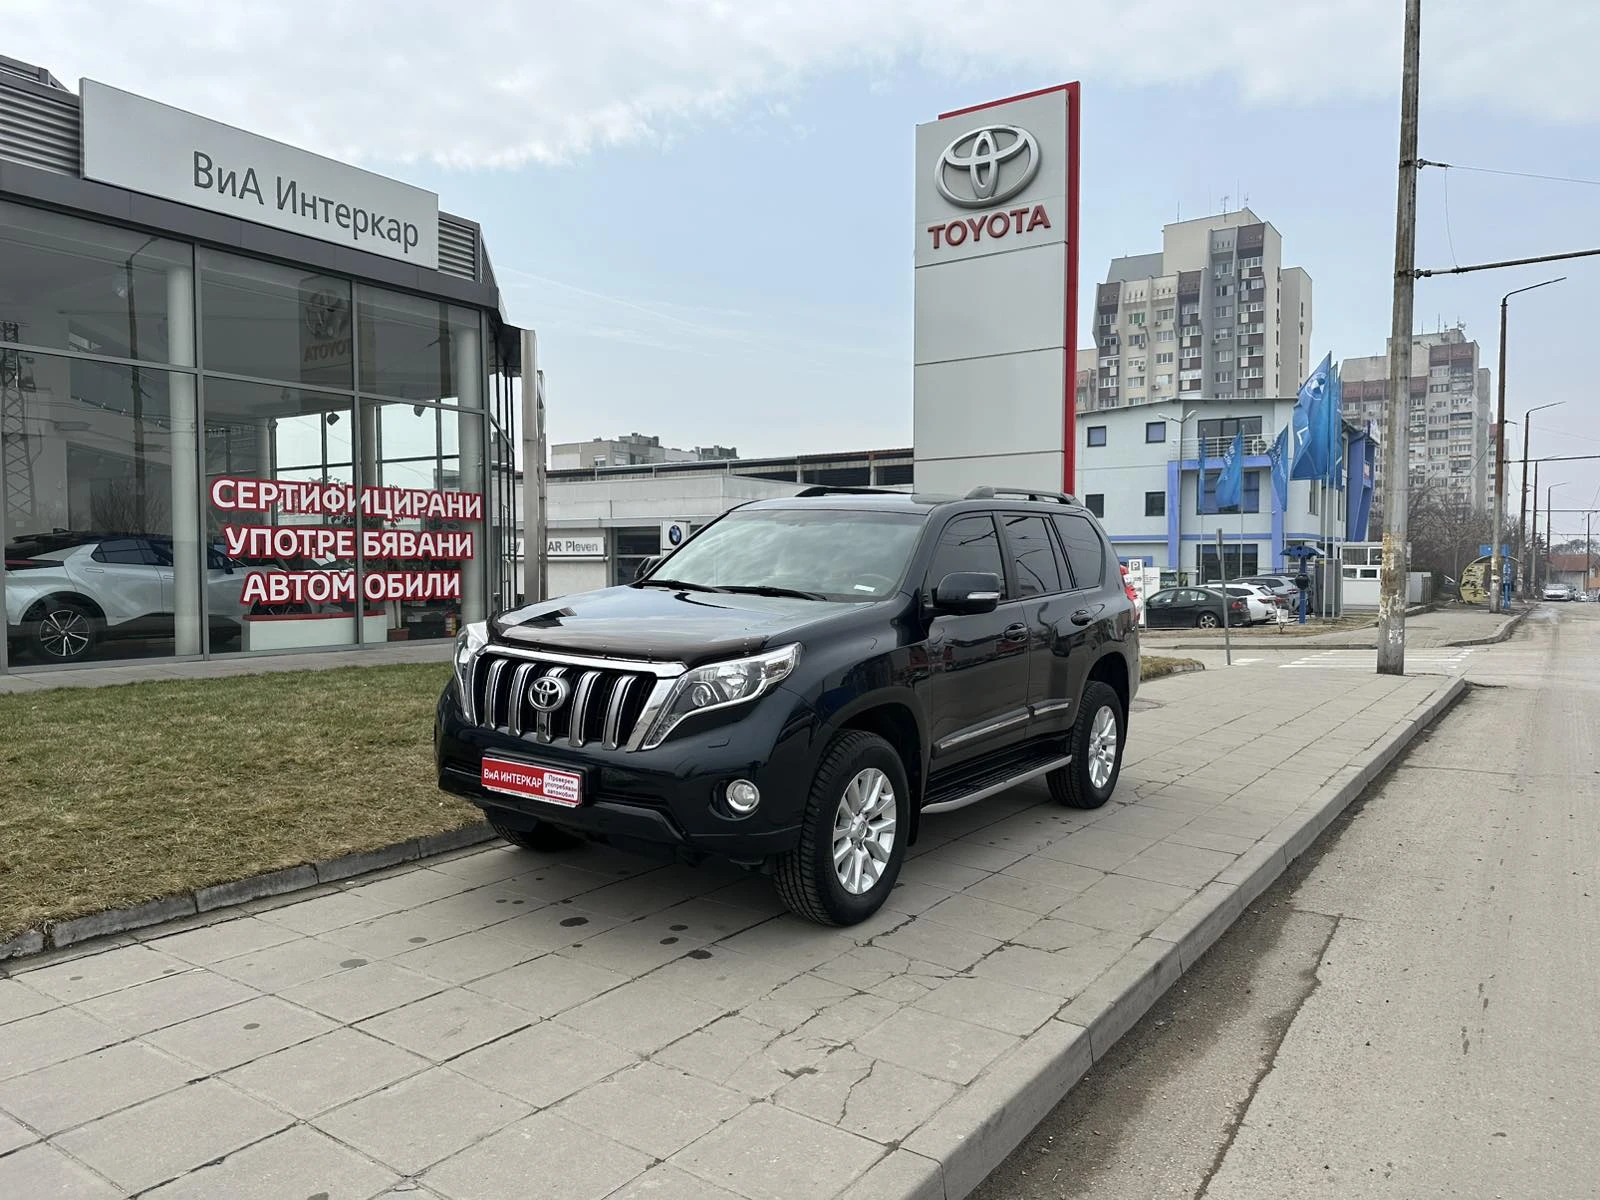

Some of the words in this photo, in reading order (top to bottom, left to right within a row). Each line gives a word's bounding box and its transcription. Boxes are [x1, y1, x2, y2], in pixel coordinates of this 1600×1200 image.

[193, 151, 264, 205] ВиА
[276, 177, 419, 254] Интеркар
[927, 204, 1051, 250] TOYOTA
[211, 479, 482, 520] СЕРТИФИЦИРАНИ
[547, 541, 562, 552] AR
[565, 541, 598, 552] Pleven
[484, 768, 499, 780] ВиА
[500, 771, 542, 788] ИНТЕРКАР
